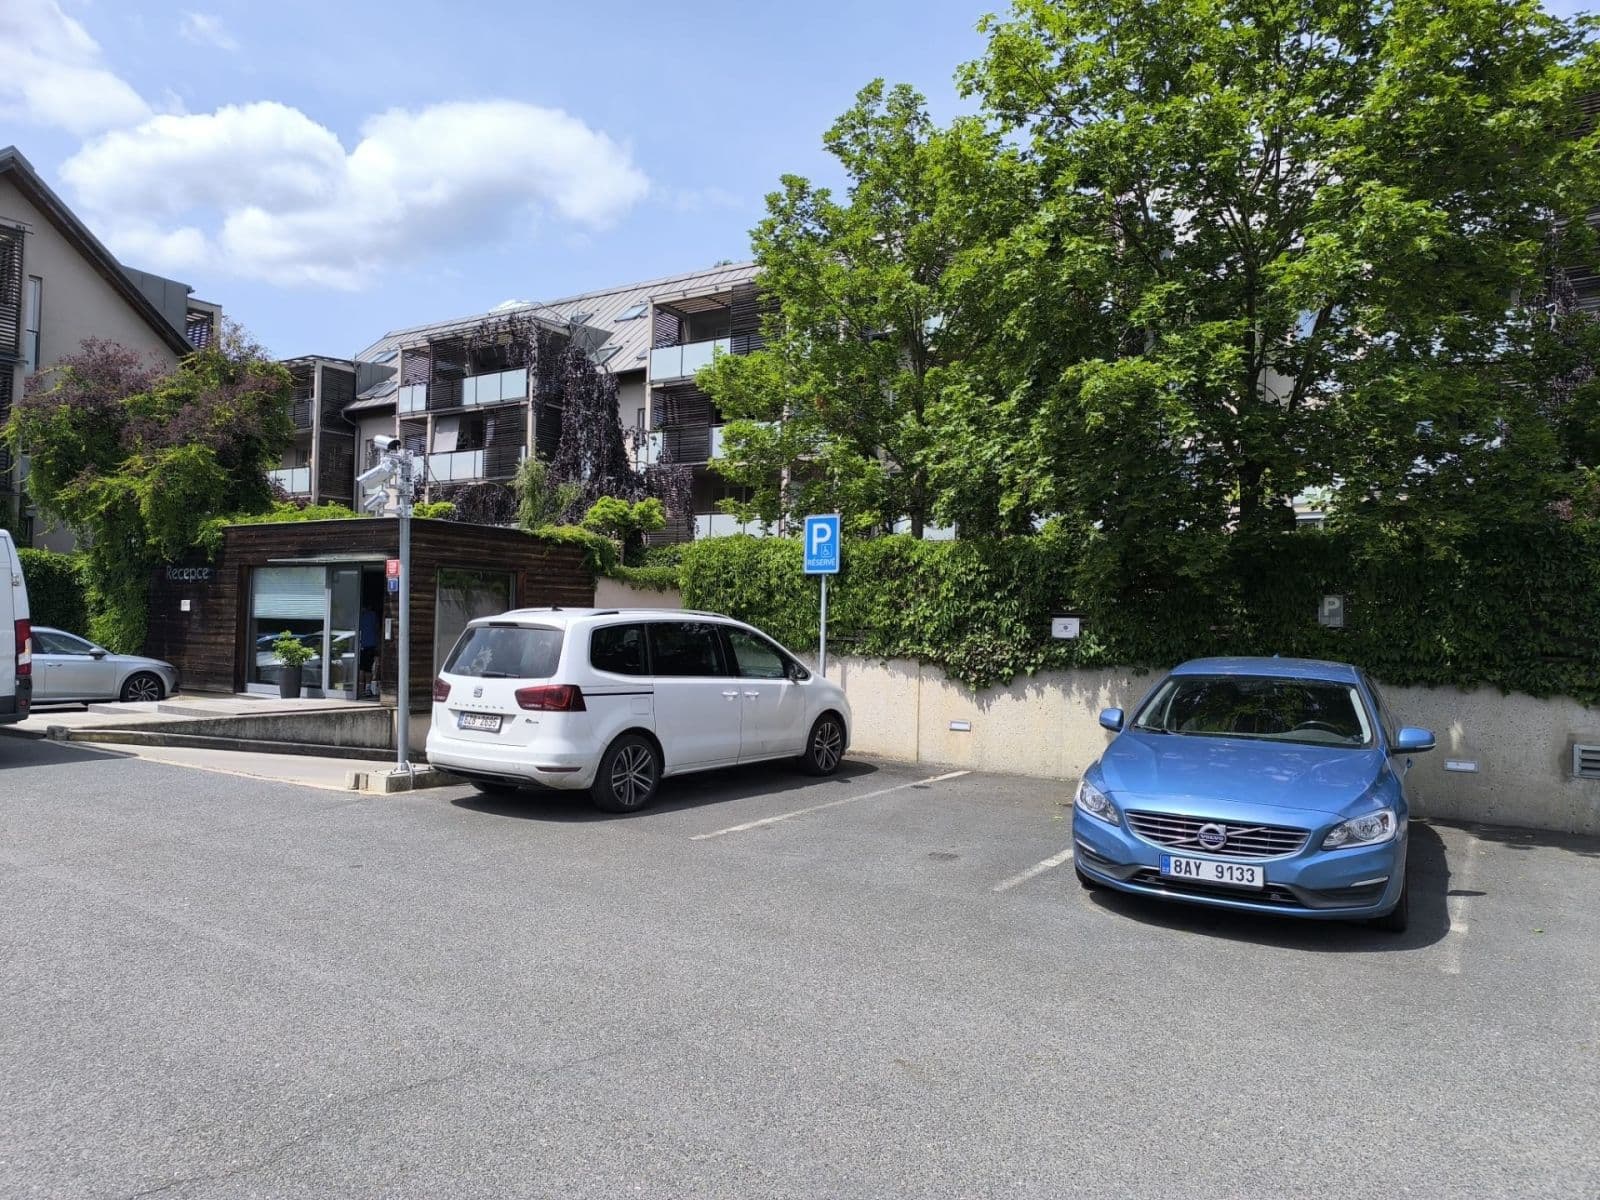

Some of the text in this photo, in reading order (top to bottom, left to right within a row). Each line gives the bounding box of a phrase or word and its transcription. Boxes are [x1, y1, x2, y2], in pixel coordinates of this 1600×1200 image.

[812, 523, 832, 556] P
[166, 565, 209, 584] Recepce
[1323, 597, 1341, 616] P
[1200, 833, 1225, 841] VOLVO
[1174, 859, 1255, 883] 8AY 9133
